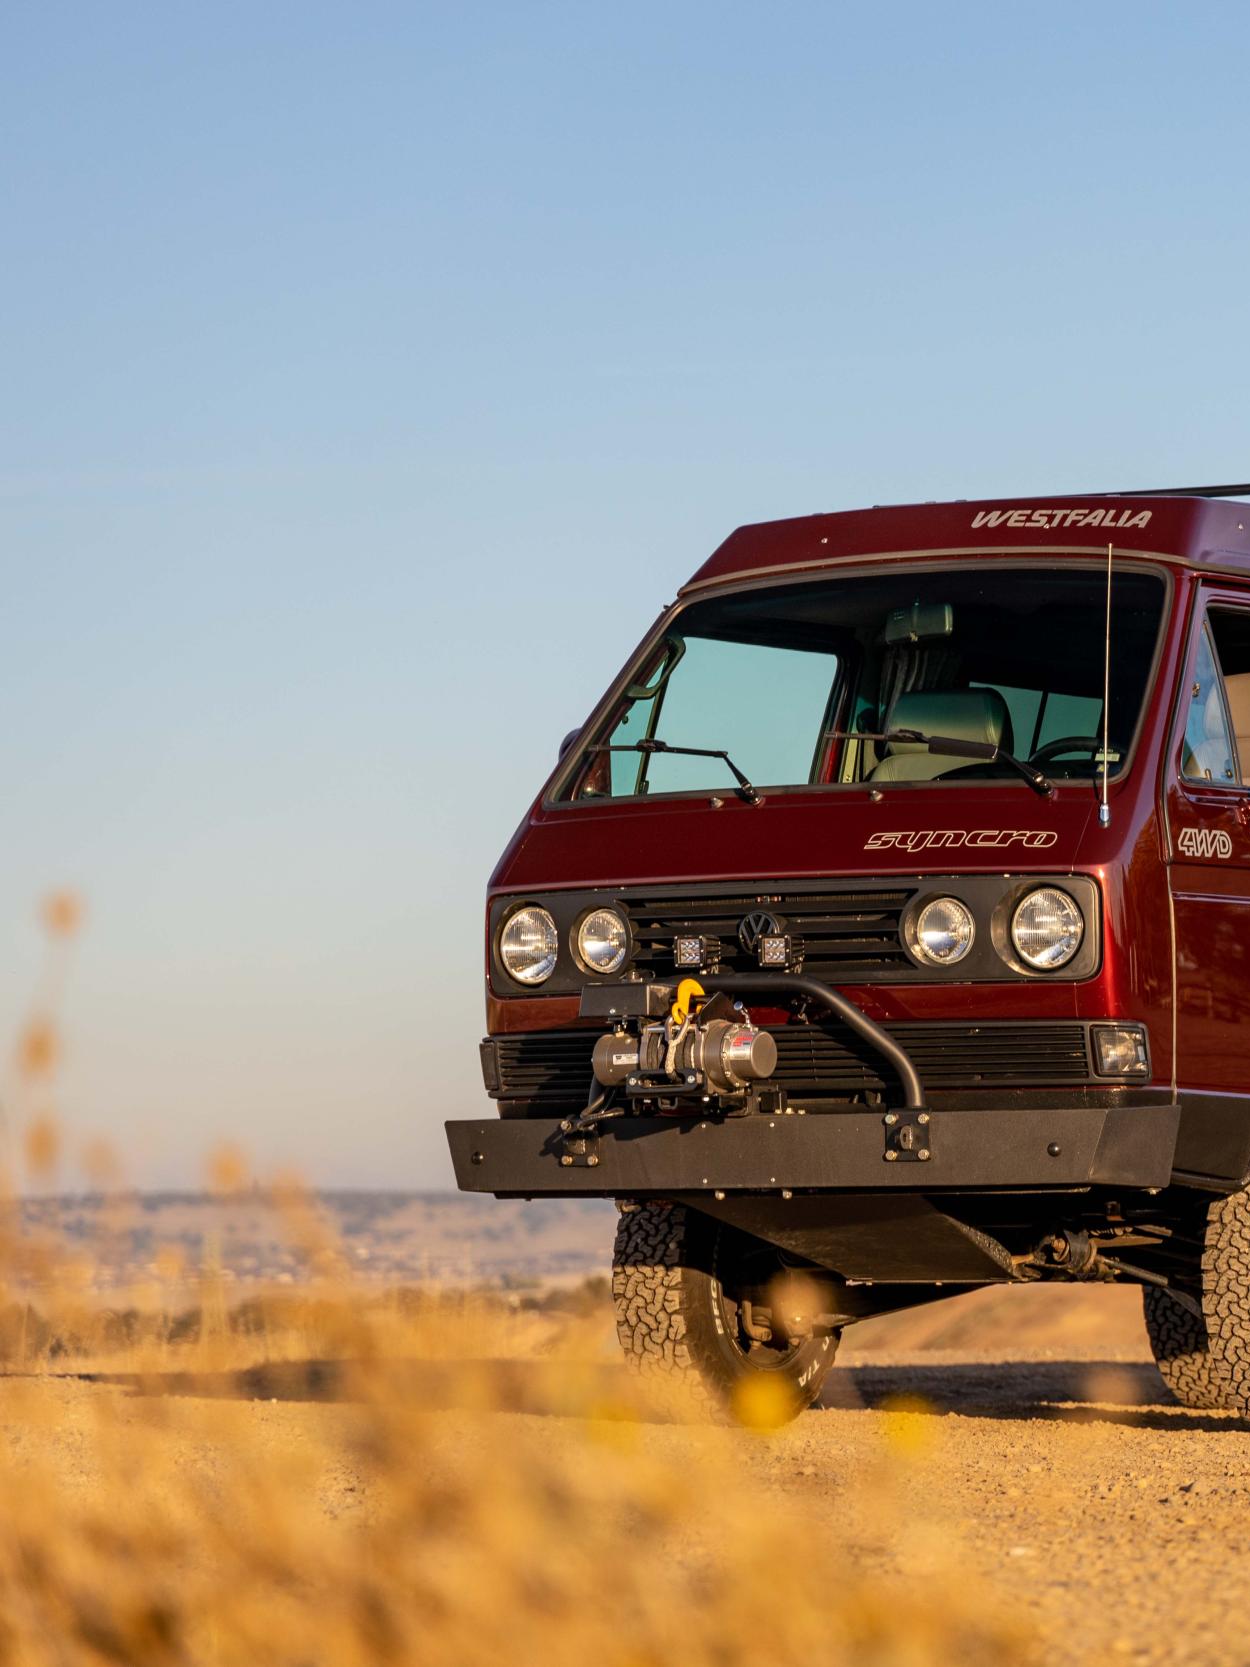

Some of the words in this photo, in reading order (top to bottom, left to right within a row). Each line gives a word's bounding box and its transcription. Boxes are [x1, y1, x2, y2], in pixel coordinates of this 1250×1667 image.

[970, 509, 1153, 529] WESTFALIA
[863, 830, 1058, 853] syncro
[1178, 827, 1232, 859] 4WD
